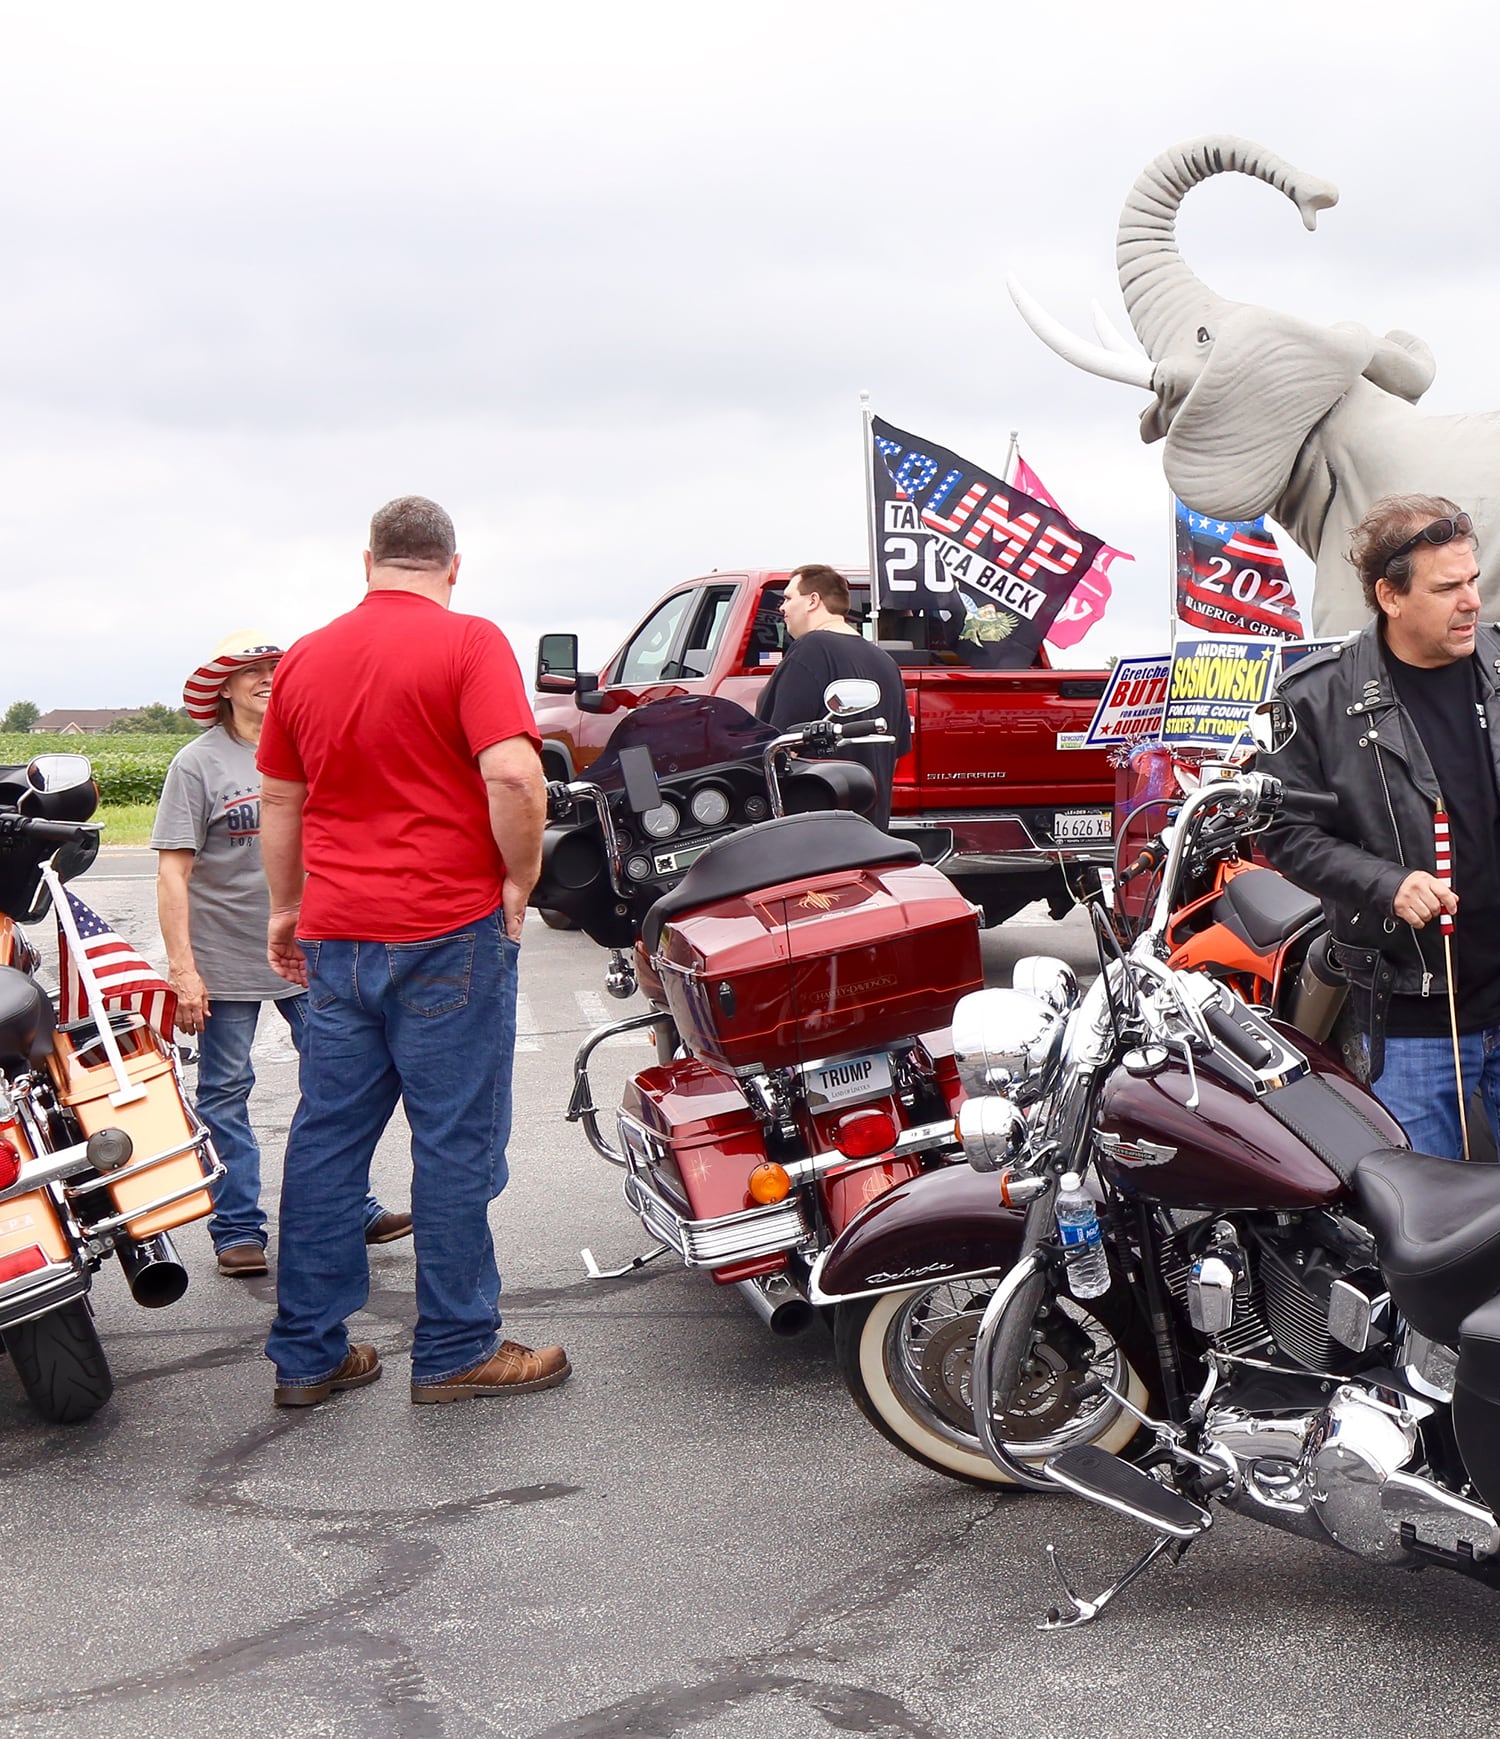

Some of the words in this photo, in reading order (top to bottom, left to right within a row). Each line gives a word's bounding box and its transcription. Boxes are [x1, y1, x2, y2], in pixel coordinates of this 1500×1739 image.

[976, 563, 1040, 614] BACK
[1195, 644, 1248, 658] ANDREW
[1121, 665, 1169, 681] Gretche
[1169, 656, 1268, 701] SOSNOWSKI
[1168, 705, 1184, 716] FOR
[1184, 705, 1210, 716] KANE
[1111, 716, 1161, 735] AUDITO
[1165, 717, 1195, 734] STATE'S
[926, 771, 1006, 780] SILVERADO
[1055, 820, 1068, 836] 16
[1072, 820, 1093, 836] 626
[230, 836, 253, 847] FOR
[819, 1060, 873, 1090] TRUMP
[865, 1262, 954, 1283] Deluxe
